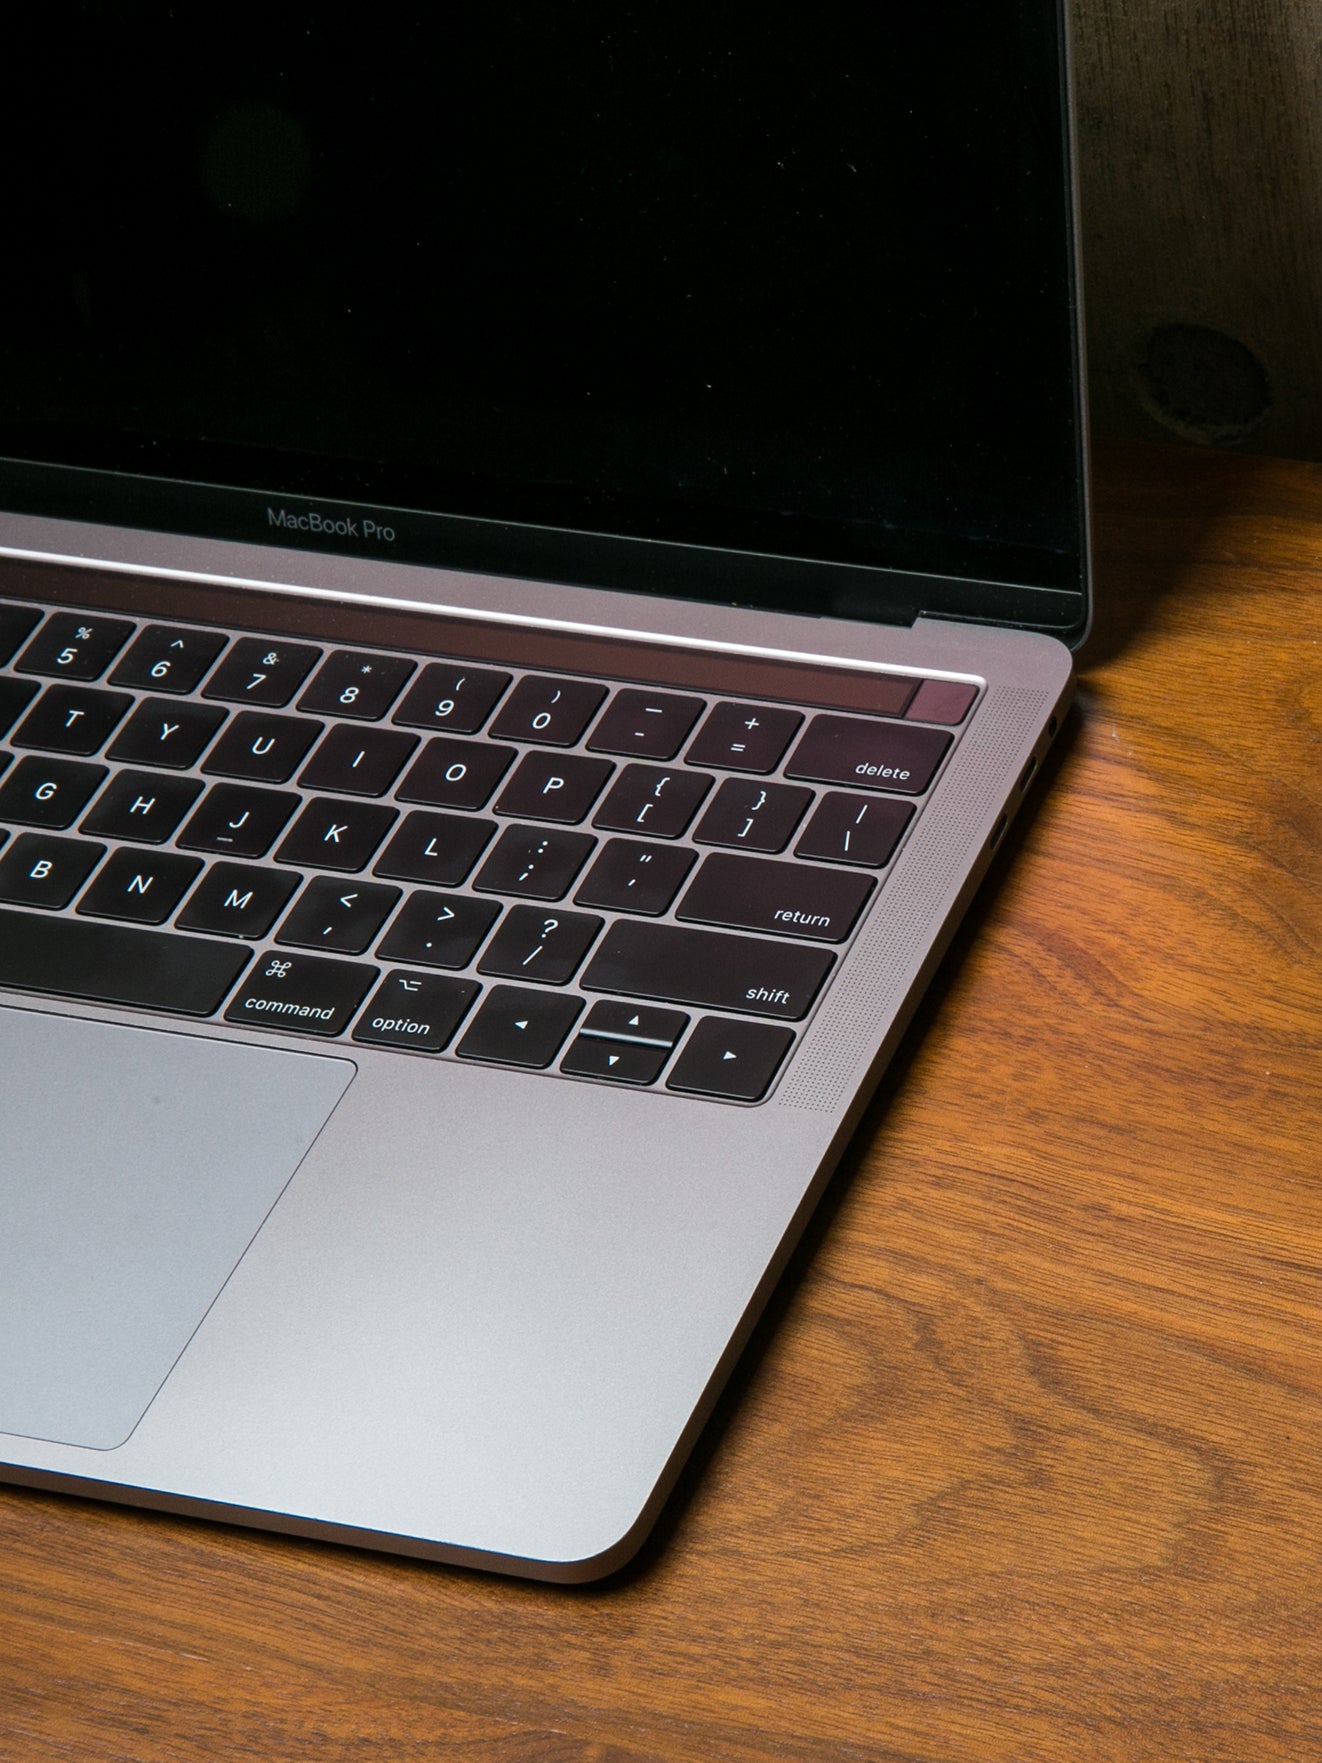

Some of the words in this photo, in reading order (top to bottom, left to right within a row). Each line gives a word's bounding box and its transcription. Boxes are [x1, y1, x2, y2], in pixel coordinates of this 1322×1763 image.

[267, 507, 360, 537] MacBook
[363, 520, 396, 542] Pro
[75, 626, 93, 640] %
[57, 647, 78, 664] 5
[262, 652, 279, 665] &
[151, 660, 171, 678] 6
[246, 673, 267, 690] 7
[339, 686, 360, 704] 8
[435, 699, 455, 717] 9
[66, 710, 85, 727] T
[532, 712, 551, 730] 0
[744, 717, 760, 730] +
[160, 723, 180, 741] Y
[252, 736, 275, 755] U
[352, 750, 365, 768] I
[445, 763, 467, 782] O
[855, 761, 911, 782] delete
[35, 782, 57, 800] G
[542, 777, 565, 794] P
[654, 777, 671, 797] {
[130, 796, 156, 815] H
[751, 790, 767, 811] }
[229, 811, 250, 829] J
[636, 803, 654, 823] [
[324, 824, 348, 843] K
[737, 818, 754, 837] ]
[424, 837, 438, 857] L
[30, 860, 53, 879] B
[127, 874, 154, 894] N
[224, 889, 253, 909] M
[340, 893, 358, 908] <
[437, 906, 455, 921] >
[774, 910, 831, 927] return
[541, 919, 559, 938] ?
[745, 987, 790, 1004] shift
[245, 998, 335, 1020] command
[372, 1017, 430, 1035] option
